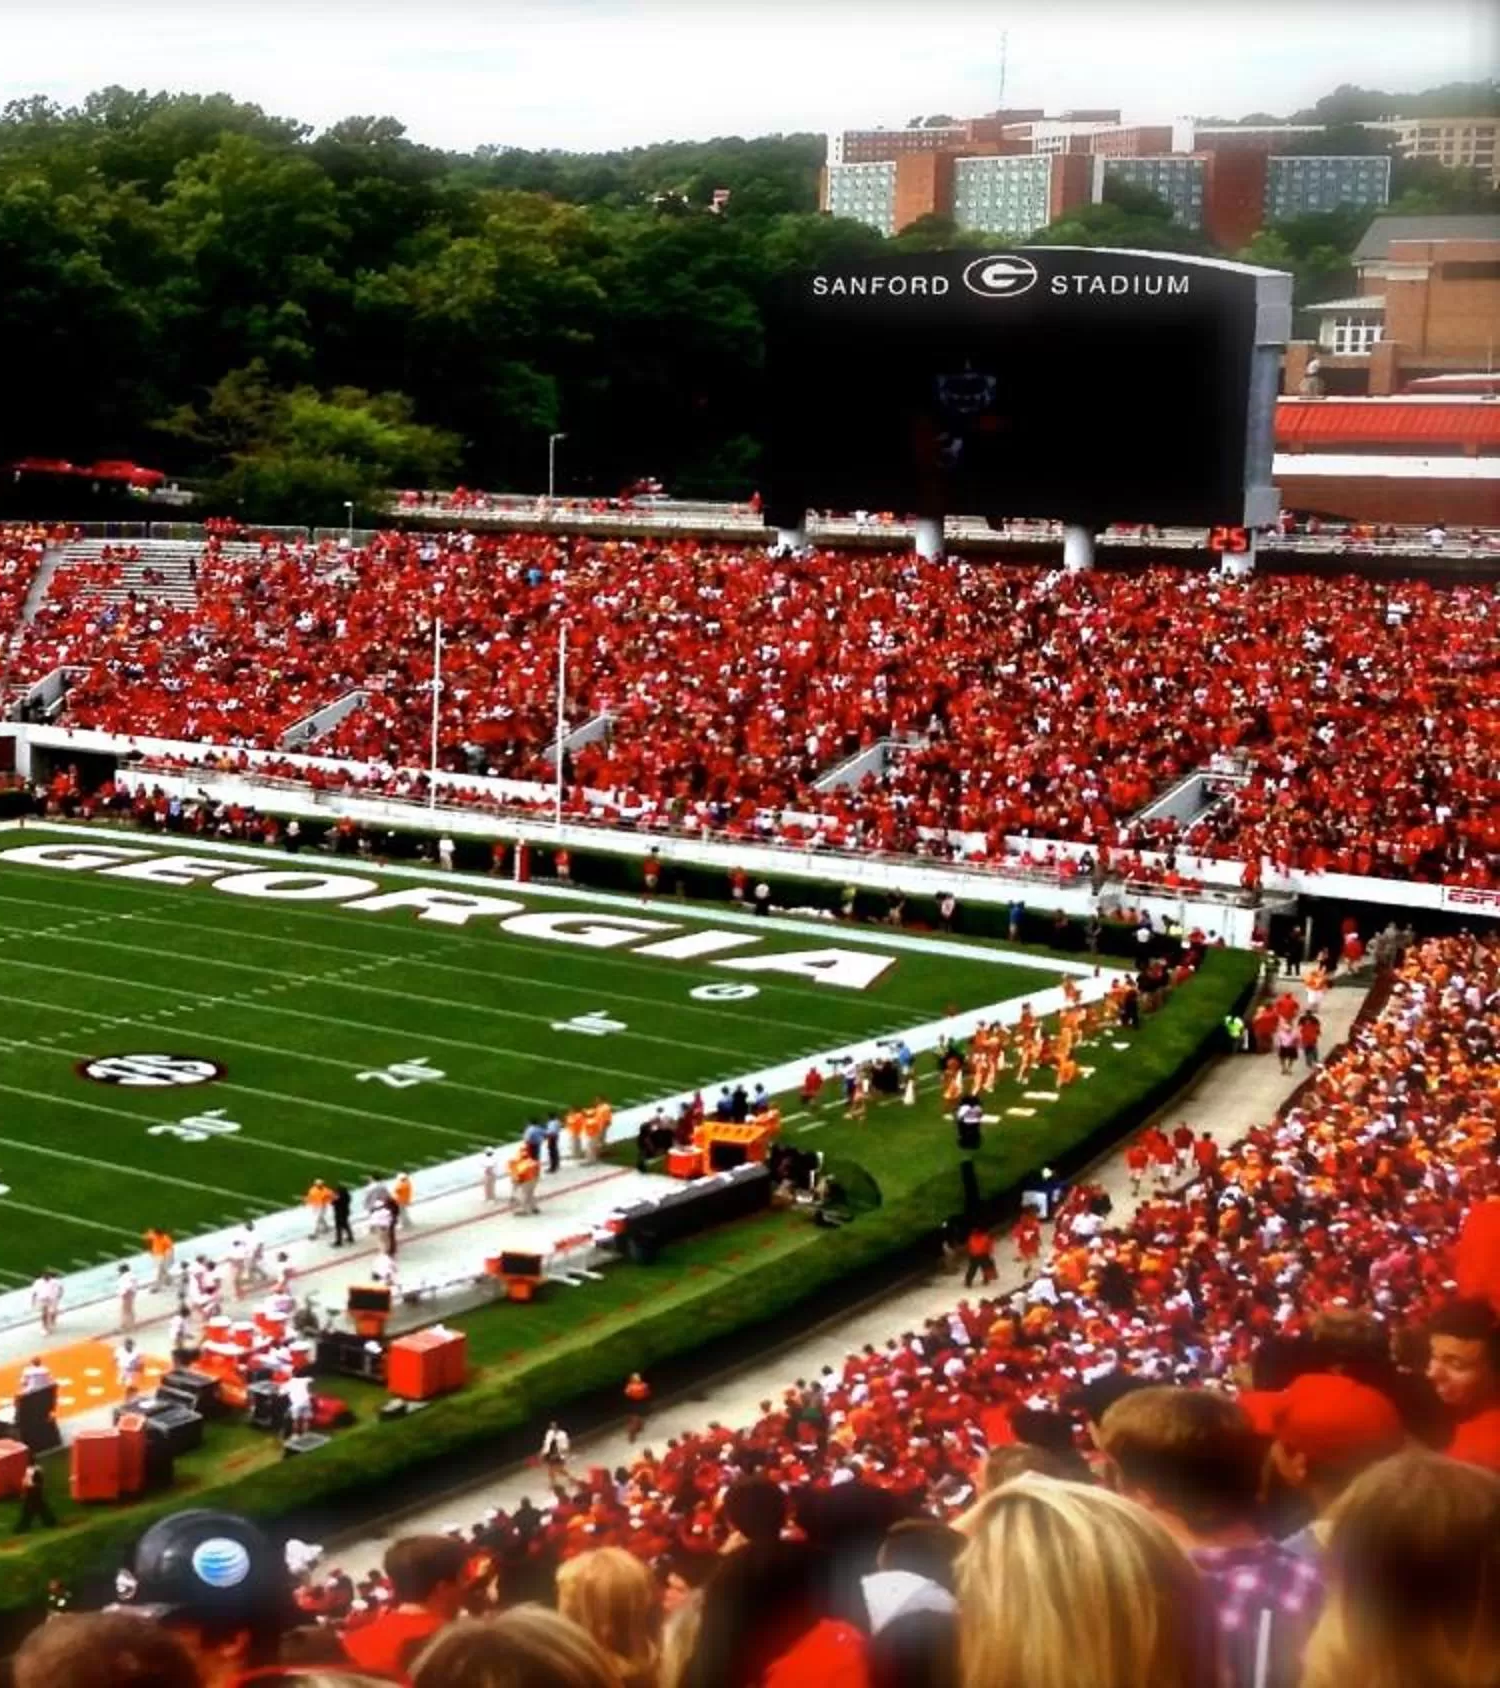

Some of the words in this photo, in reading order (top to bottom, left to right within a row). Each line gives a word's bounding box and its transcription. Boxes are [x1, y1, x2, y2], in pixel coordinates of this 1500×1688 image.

[813, 275, 949, 295] SANFORD
[1051, 275, 1189, 295] STADIUM
[1212, 527, 1247, 551] 25
[355, 1063, 447, 1089] 20
[146, 1116, 242, 1143] 30
